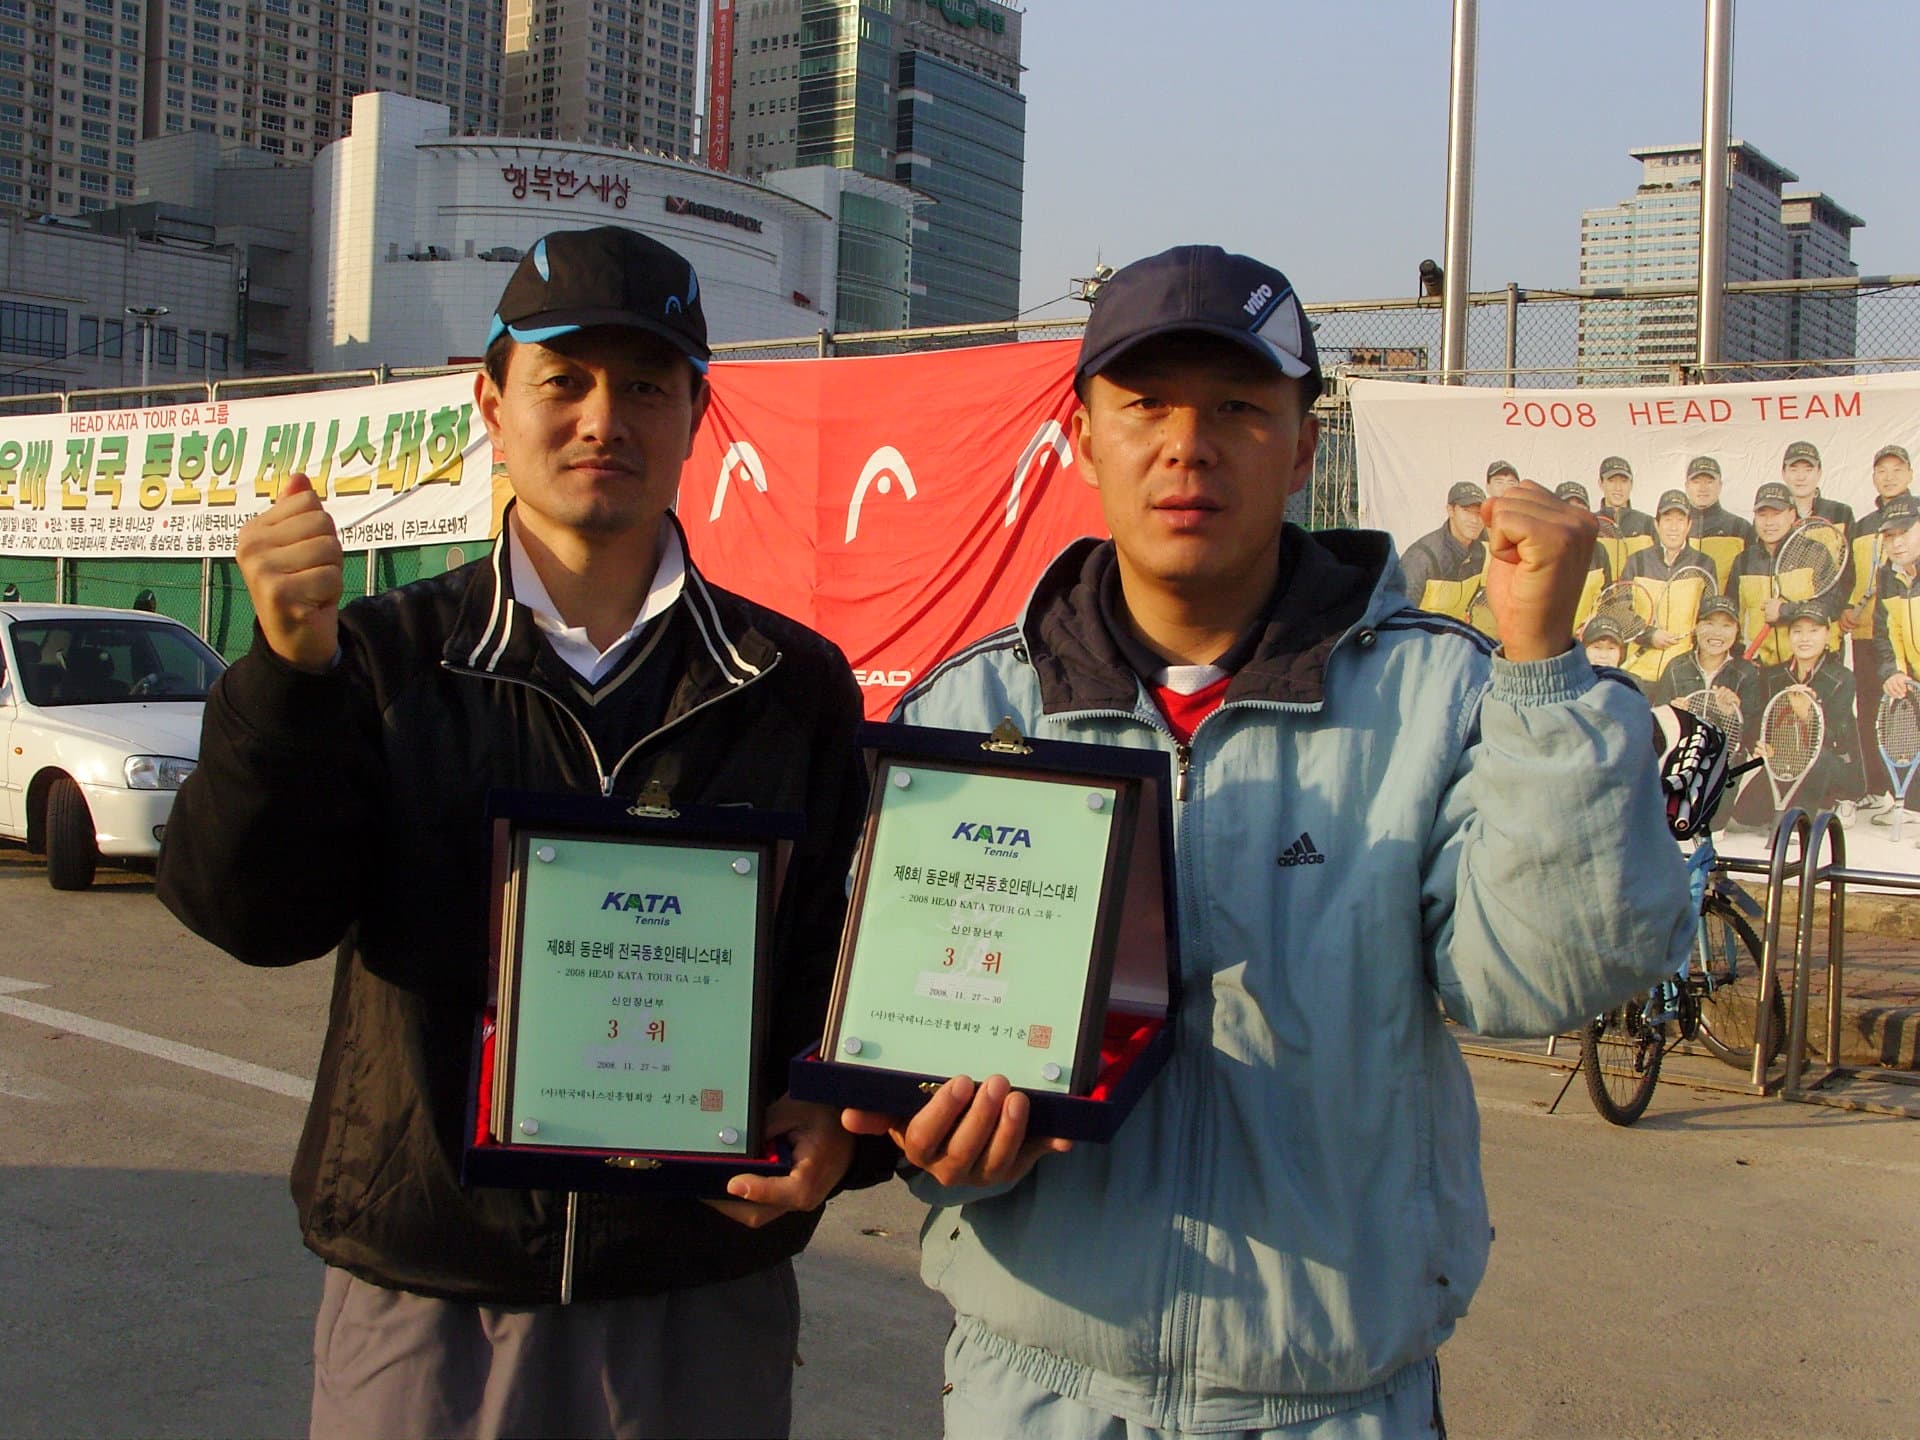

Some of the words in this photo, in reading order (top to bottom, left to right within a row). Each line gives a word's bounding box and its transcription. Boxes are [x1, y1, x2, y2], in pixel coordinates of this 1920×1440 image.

[501, 163, 631, 208] 행복한세상
[1243, 284, 1273, 316] vitro
[71, 416, 103, 432] HEAD
[108, 413, 138, 431] KATA
[143, 410, 177, 428] TOUR
[181, 408, 199, 426] GA
[204, 404, 229, 425] 그룹
[1503, 402, 1596, 428] 2008
[1629, 400, 1732, 426] HEAD
[1752, 392, 1861, 421] TEAM
[61, 437, 129, 510] 전국
[140, 427, 248, 511] 동호인
[254, 403, 474, 504] 테니스대회
[125, 516, 154, 533] 테니스장
[170, 516, 184, 532] 주관
[852, 670, 911, 686] EAD
[952, 822, 1031, 848] KATA
[984, 847, 1019, 858] Tennis
[1278, 852, 1325, 867] adidas
[893, 865, 922, 884] 제8회
[926, 869, 960, 888] 동운배
[963, 872, 1078, 902] 전국동호인테니스대회
[601, 892, 682, 915] KATA
[908, 894, 928, 904] 2008
[931, 896, 957, 907] HEAD
[959, 901, 985, 911] KATA
[989, 903, 1014, 916] TOUR
[1018, 907, 1031, 917] GA
[635, 915, 670, 927] Tennis
[547, 939, 575, 956] 제8회
[580, 941, 614, 959] 동운배
[618, 943, 732, 965] 전국동호인테니스대회
[943, 947, 955, 967] 3
[981, 951, 1001, 974] 위
[565, 968, 585, 977] 2008
[589, 969, 614, 979] HEAD
[618, 970, 643, 981] KATA
[648, 972, 672, 983] TOUR
[675, 974, 689, 983] GA
[607, 1019, 618, 1038] 3
[646, 1020, 665, 1042] 위
